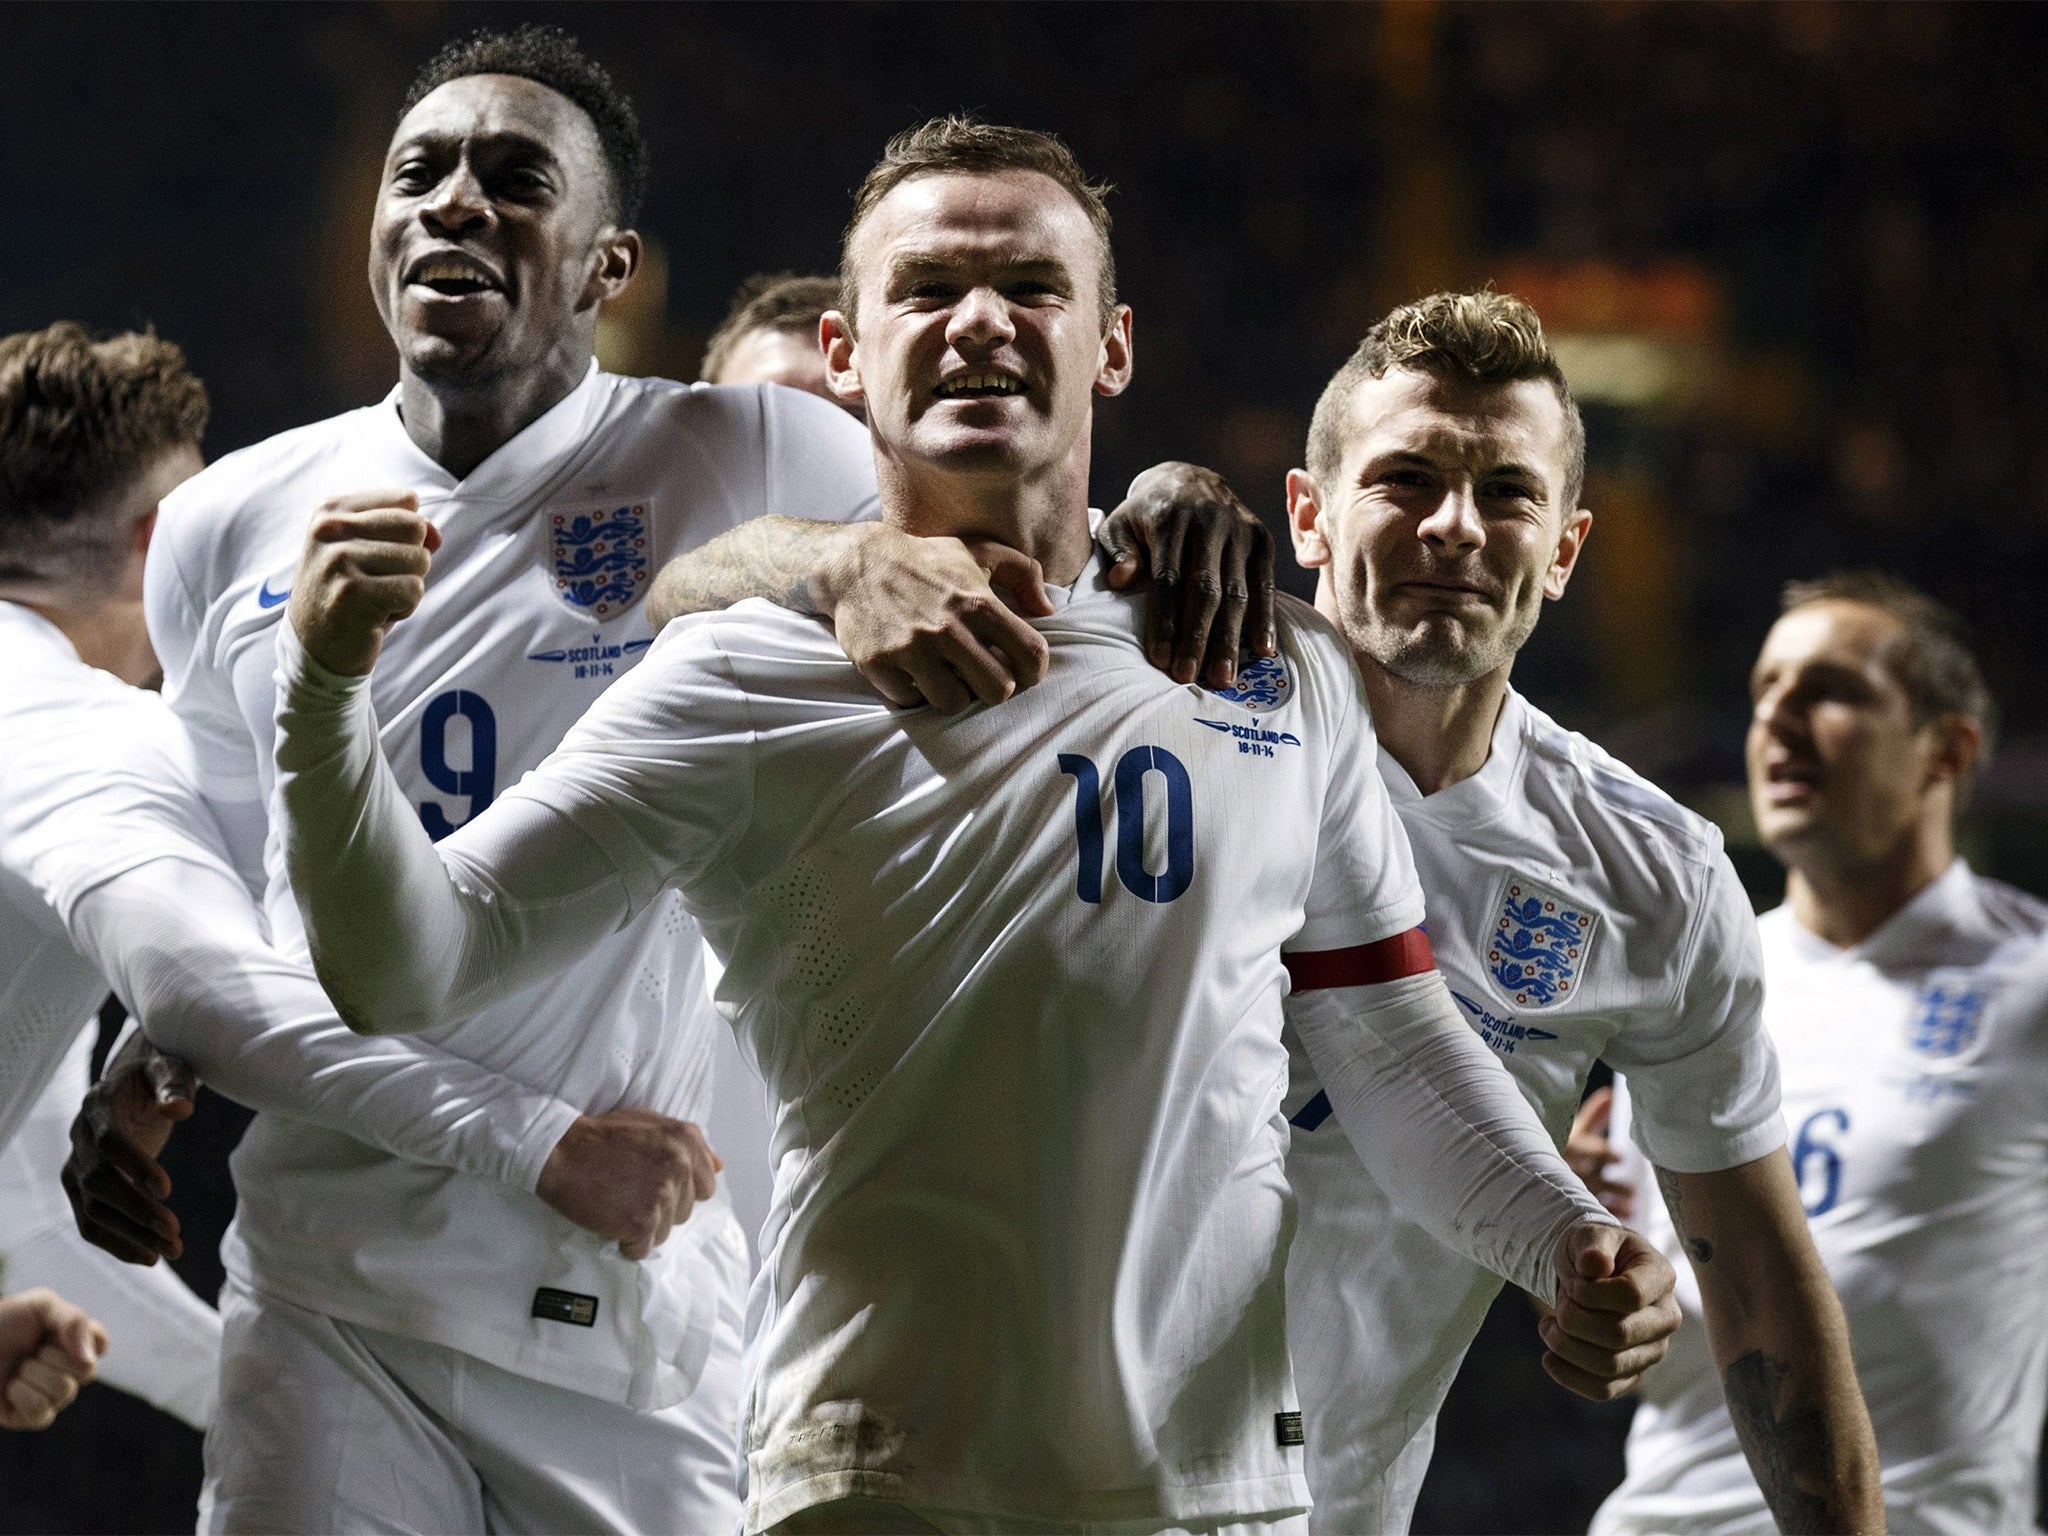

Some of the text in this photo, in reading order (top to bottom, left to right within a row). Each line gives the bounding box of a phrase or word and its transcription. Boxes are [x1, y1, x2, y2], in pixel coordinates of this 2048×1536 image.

[568, 645, 621, 662] SCOTLAND
[420, 689, 496, 844] 9
[1231, 724, 1279, 744] SCOTLAND
[1057, 745, 1194, 903] 10
[1481, 1012, 1526, 1040] SCOTLAND
[1794, 1108, 1849, 1217] 6
